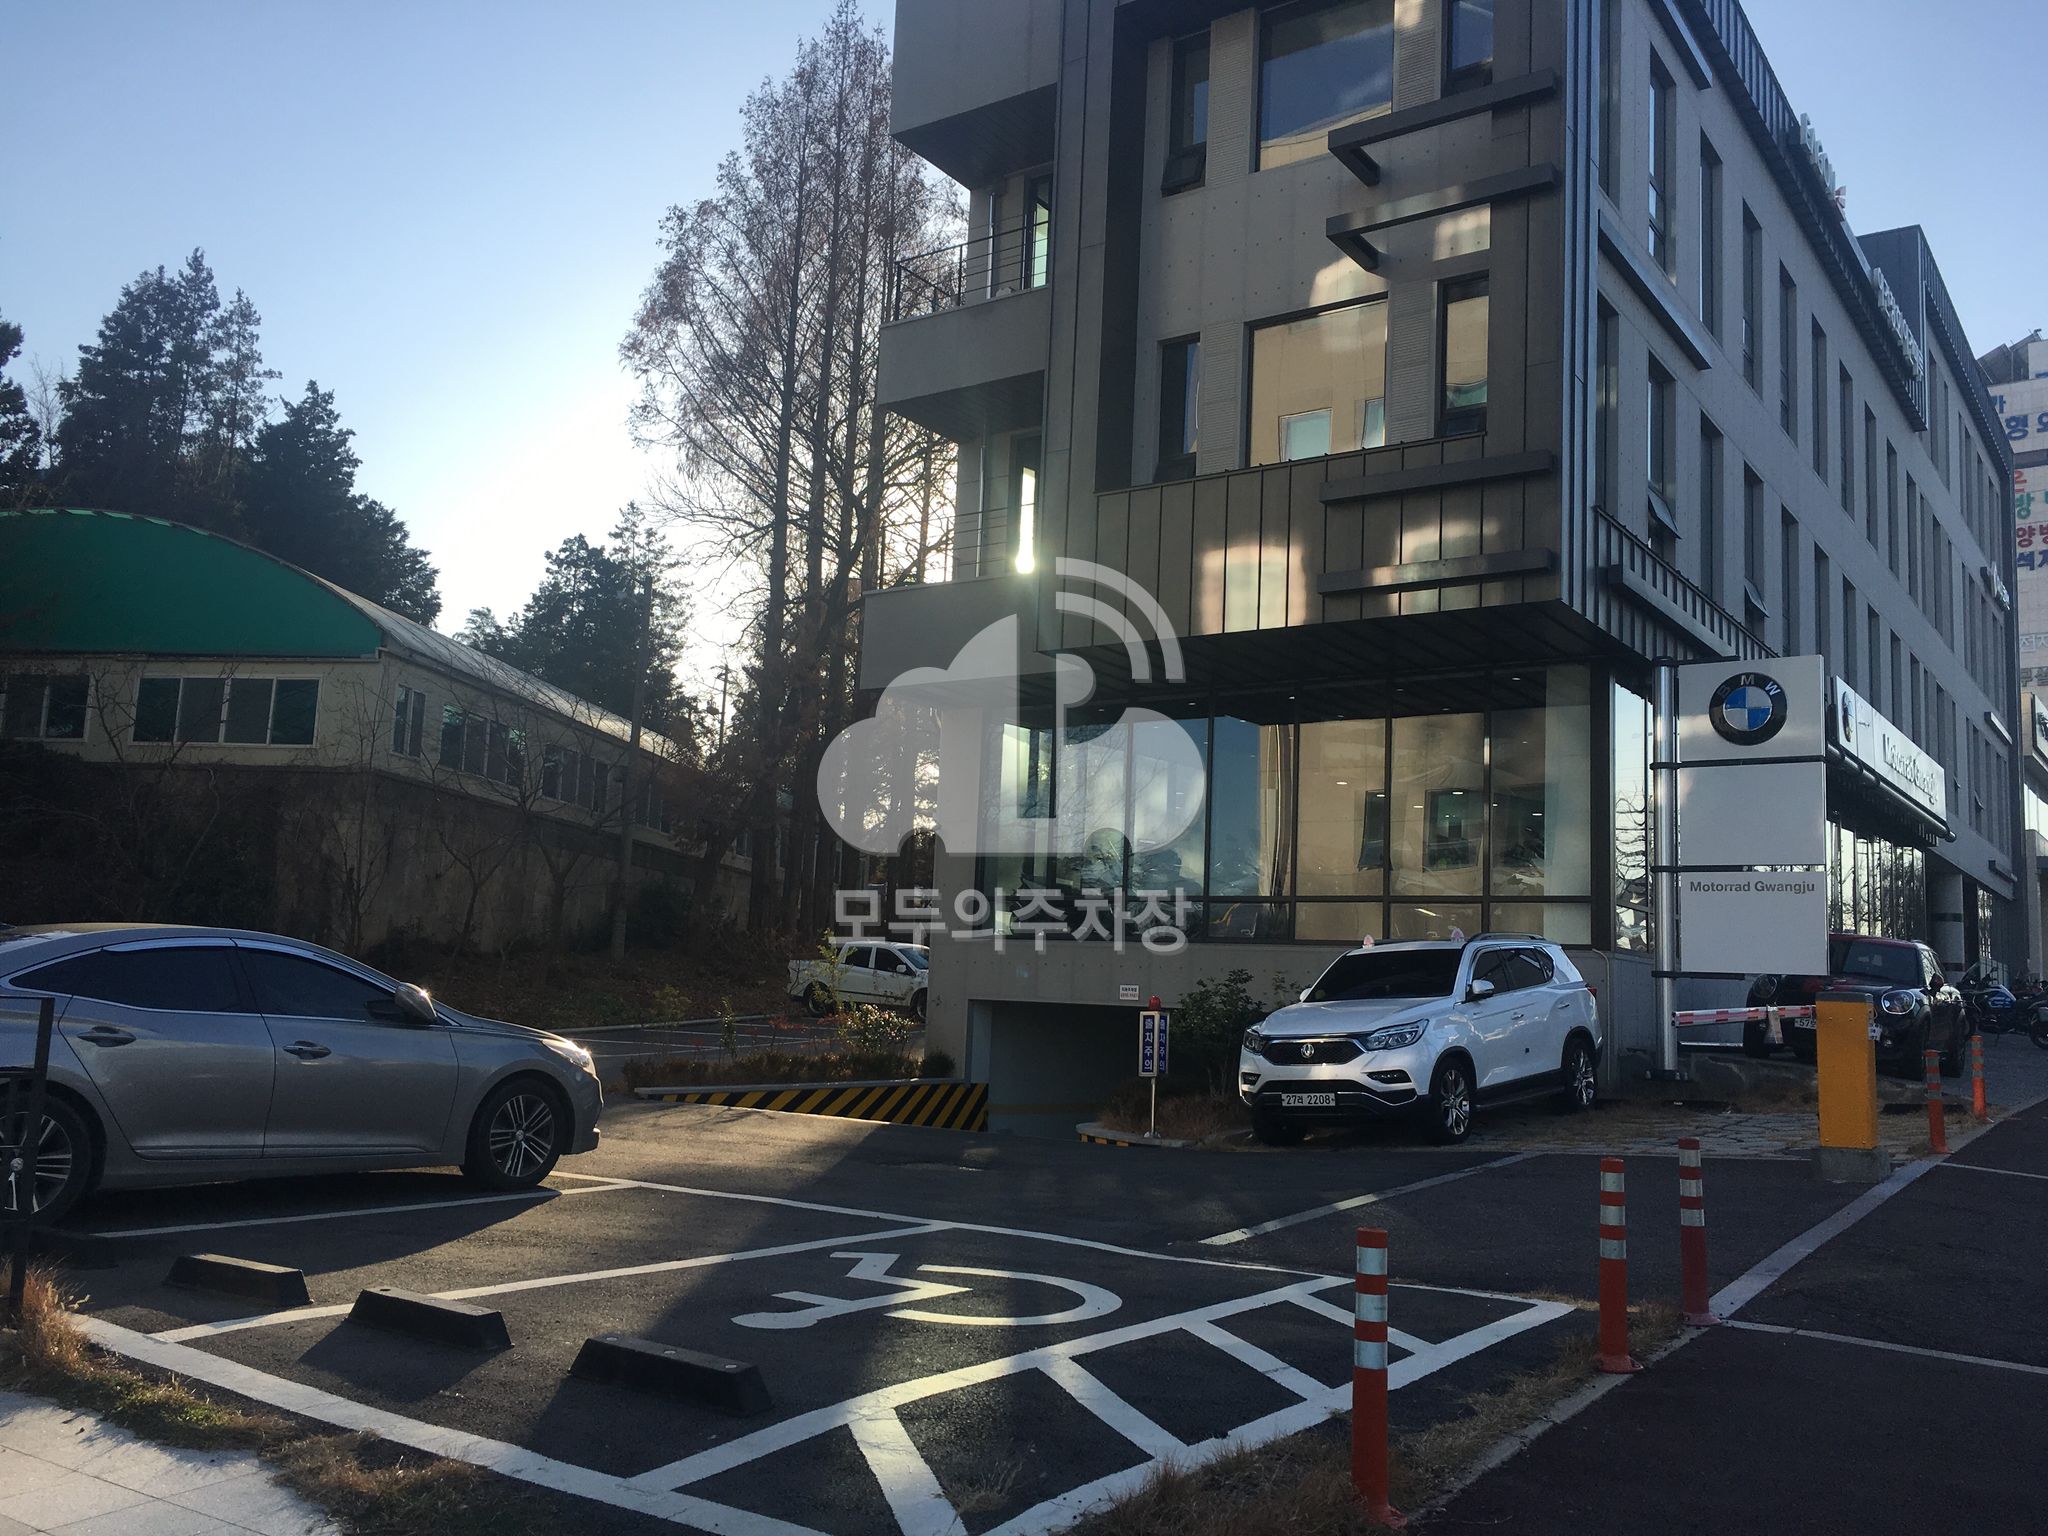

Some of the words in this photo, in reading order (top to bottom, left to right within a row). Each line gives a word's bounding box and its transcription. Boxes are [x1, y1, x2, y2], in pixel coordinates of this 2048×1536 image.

[1717, 674, 1781, 699] BMW
[1690, 881, 1750, 892] Motorrad
[1754, 881, 1815, 894] Gwangju
[1307, 1094, 1331, 1105] 2208
